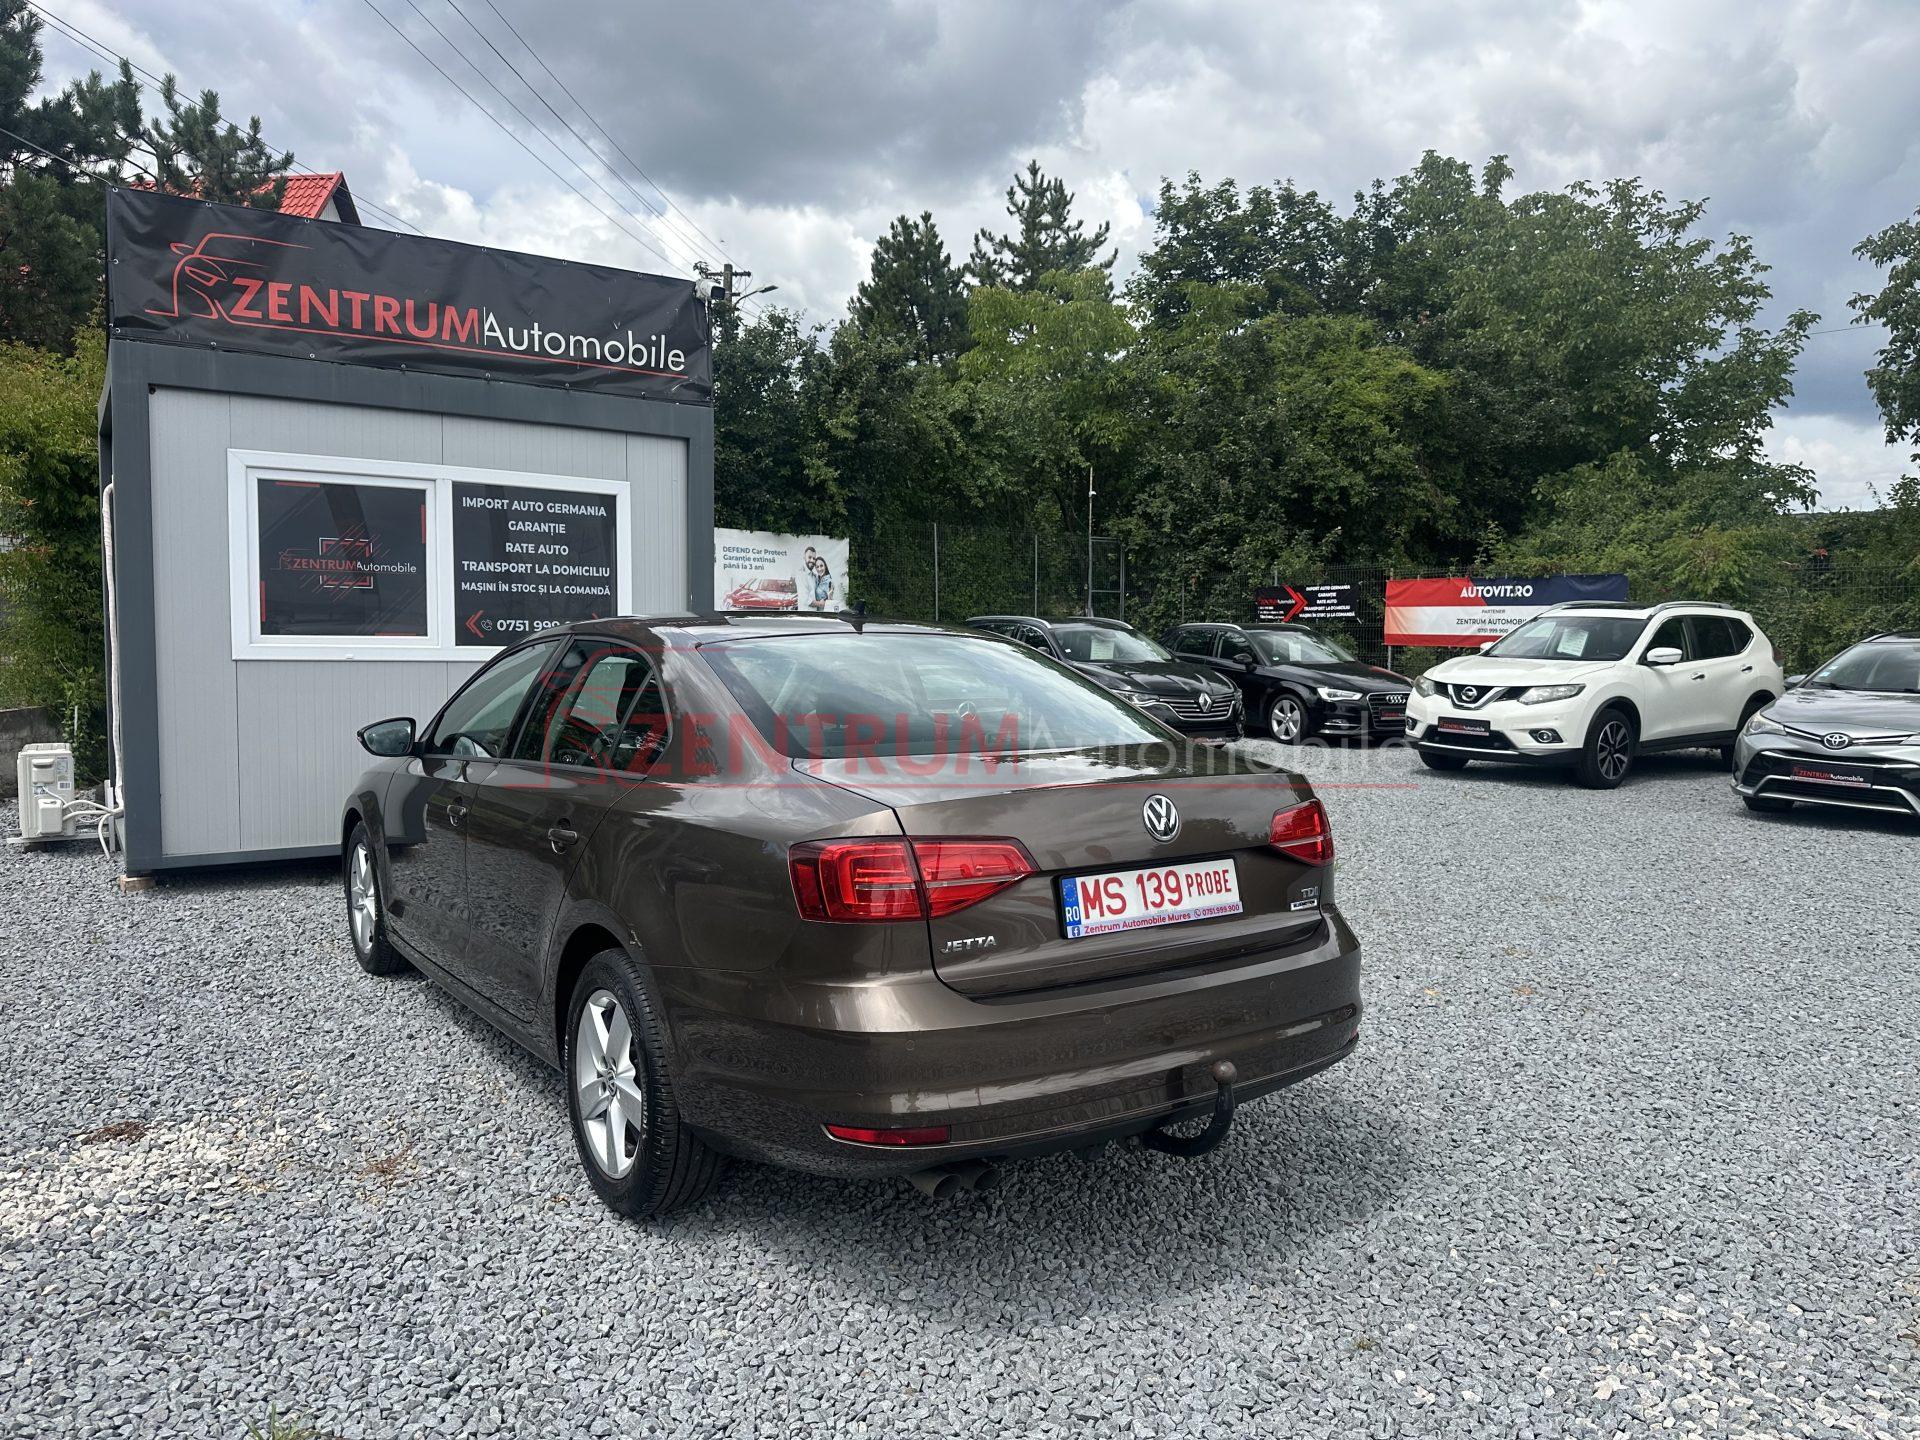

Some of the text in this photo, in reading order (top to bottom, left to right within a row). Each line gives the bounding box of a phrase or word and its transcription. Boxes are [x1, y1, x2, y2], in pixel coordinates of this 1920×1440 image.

[230, 277, 686, 372] ZENTRUM Automobile
[462, 497, 606, 516] IMPORT AUTO GERMANIA
[505, 542, 569, 556] RATE AUTO
[723, 546, 750, 554] DEFEND
[292, 558, 416, 573] ZENTRUM Automobile
[462, 560, 610, 577] TRANSPORT LA DOMICILIU
[498, 581, 509, 592] ÎN
[511, 583, 536, 593] STOC
[550, 585, 562, 594] LA
[564, 585, 611, 596] COMANDĂ
[1460, 584, 1533, 598] AUTOVIT.RO
[496, 620, 530, 632] 0751
[1066, 869, 1232, 922] RO MS 139 PROBE
[1084, 921, 1120, 935] Zentrum
[1122, 915, 1166, 929] Automobile
[1168, 911, 1191, 921] Mures
[940, 935, 997, 953] JETTA
